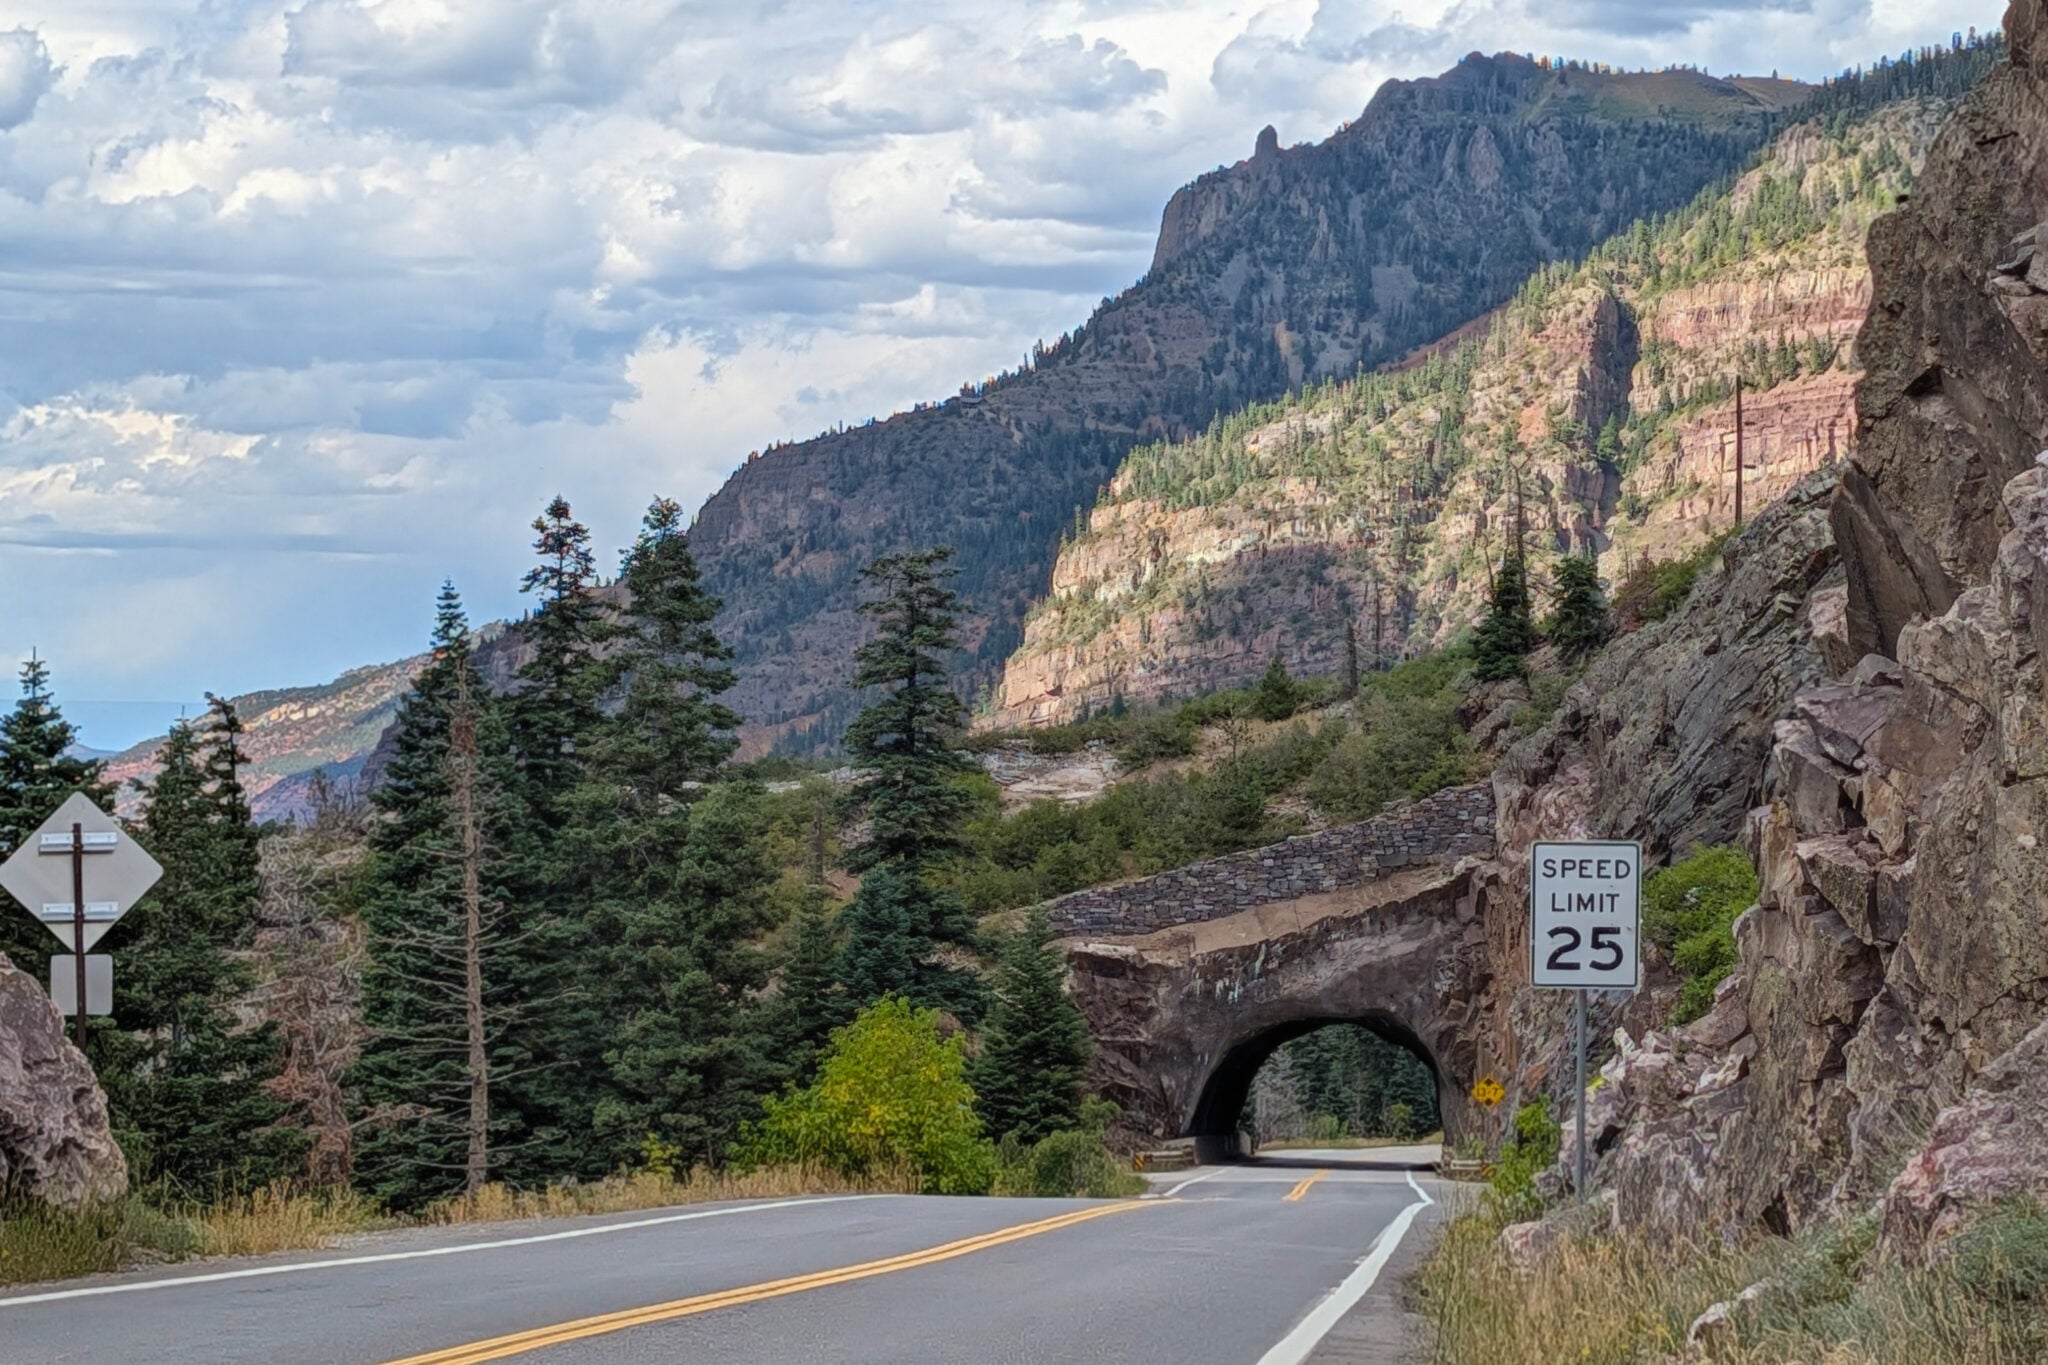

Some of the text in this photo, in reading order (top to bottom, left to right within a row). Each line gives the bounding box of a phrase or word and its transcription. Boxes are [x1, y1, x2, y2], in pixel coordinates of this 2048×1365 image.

[1542, 859, 1631, 879] SPEED
[1551, 892, 1620, 913] LIMIT
[1546, 926, 1624, 971] 25
